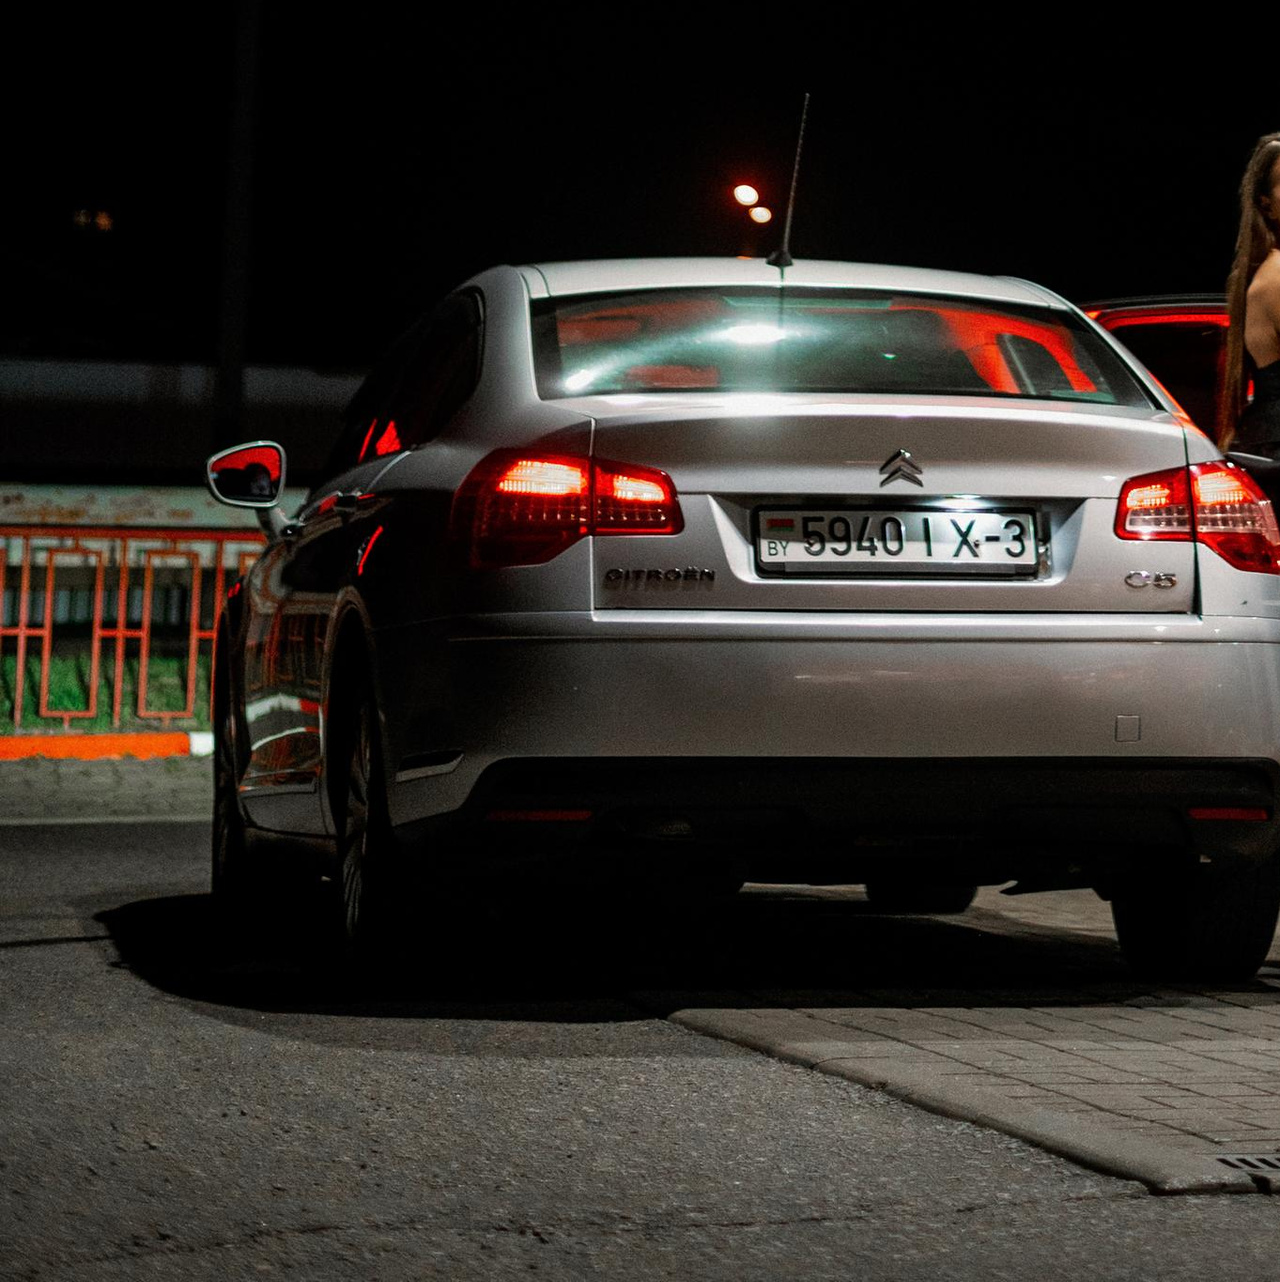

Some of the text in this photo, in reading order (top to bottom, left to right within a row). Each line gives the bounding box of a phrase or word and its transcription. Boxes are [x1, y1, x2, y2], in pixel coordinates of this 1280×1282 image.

[801, 516, 905, 557] 5940
[767, 540, 790, 557] BY
[1124, 570, 1177, 590] C5
